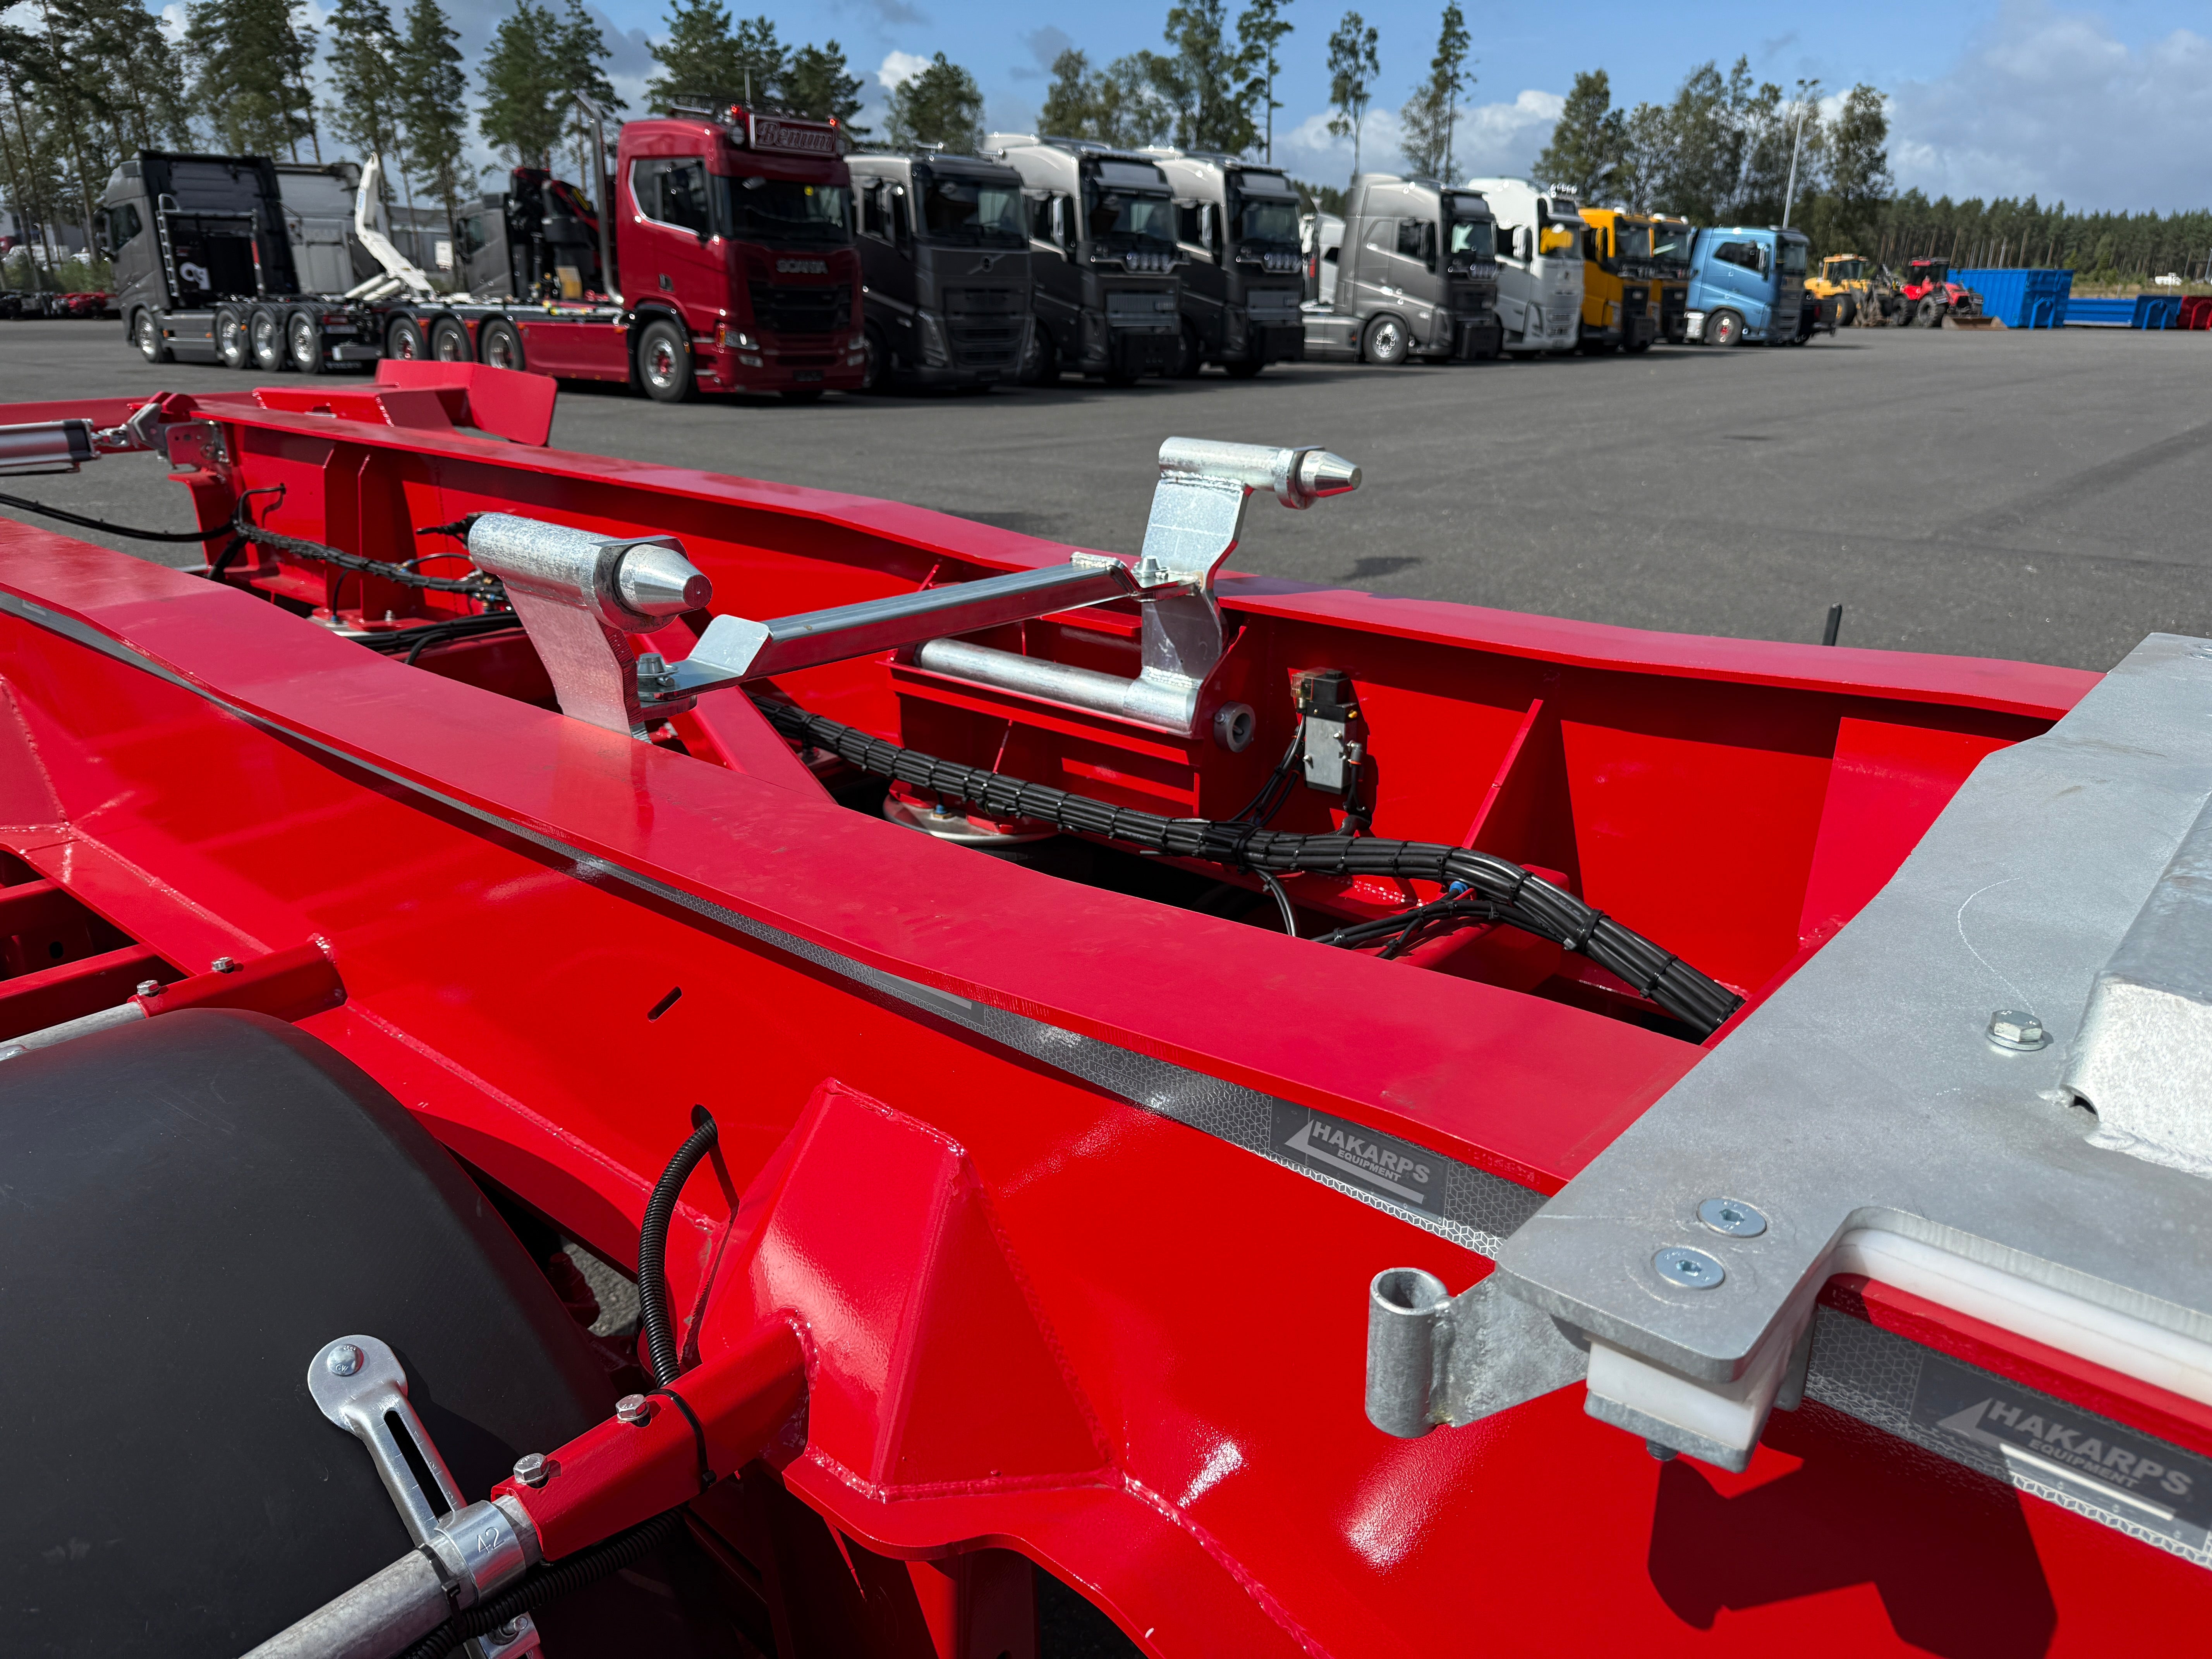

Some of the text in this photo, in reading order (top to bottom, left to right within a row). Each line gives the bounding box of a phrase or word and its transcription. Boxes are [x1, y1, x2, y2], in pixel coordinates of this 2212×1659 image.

[1094, 1064, 1105, 1075] 104
[1312, 1121, 1430, 1183] HAKARPS
[1338, 1149, 1401, 1182] EQUIPMENT
[1988, 1400, 2193, 1496] HAKARPS
[2028, 1438, 2140, 1488] EQUIPMENT
[429, 1461, 436, 1470] 2
[477, 1527, 505, 1554] 42
